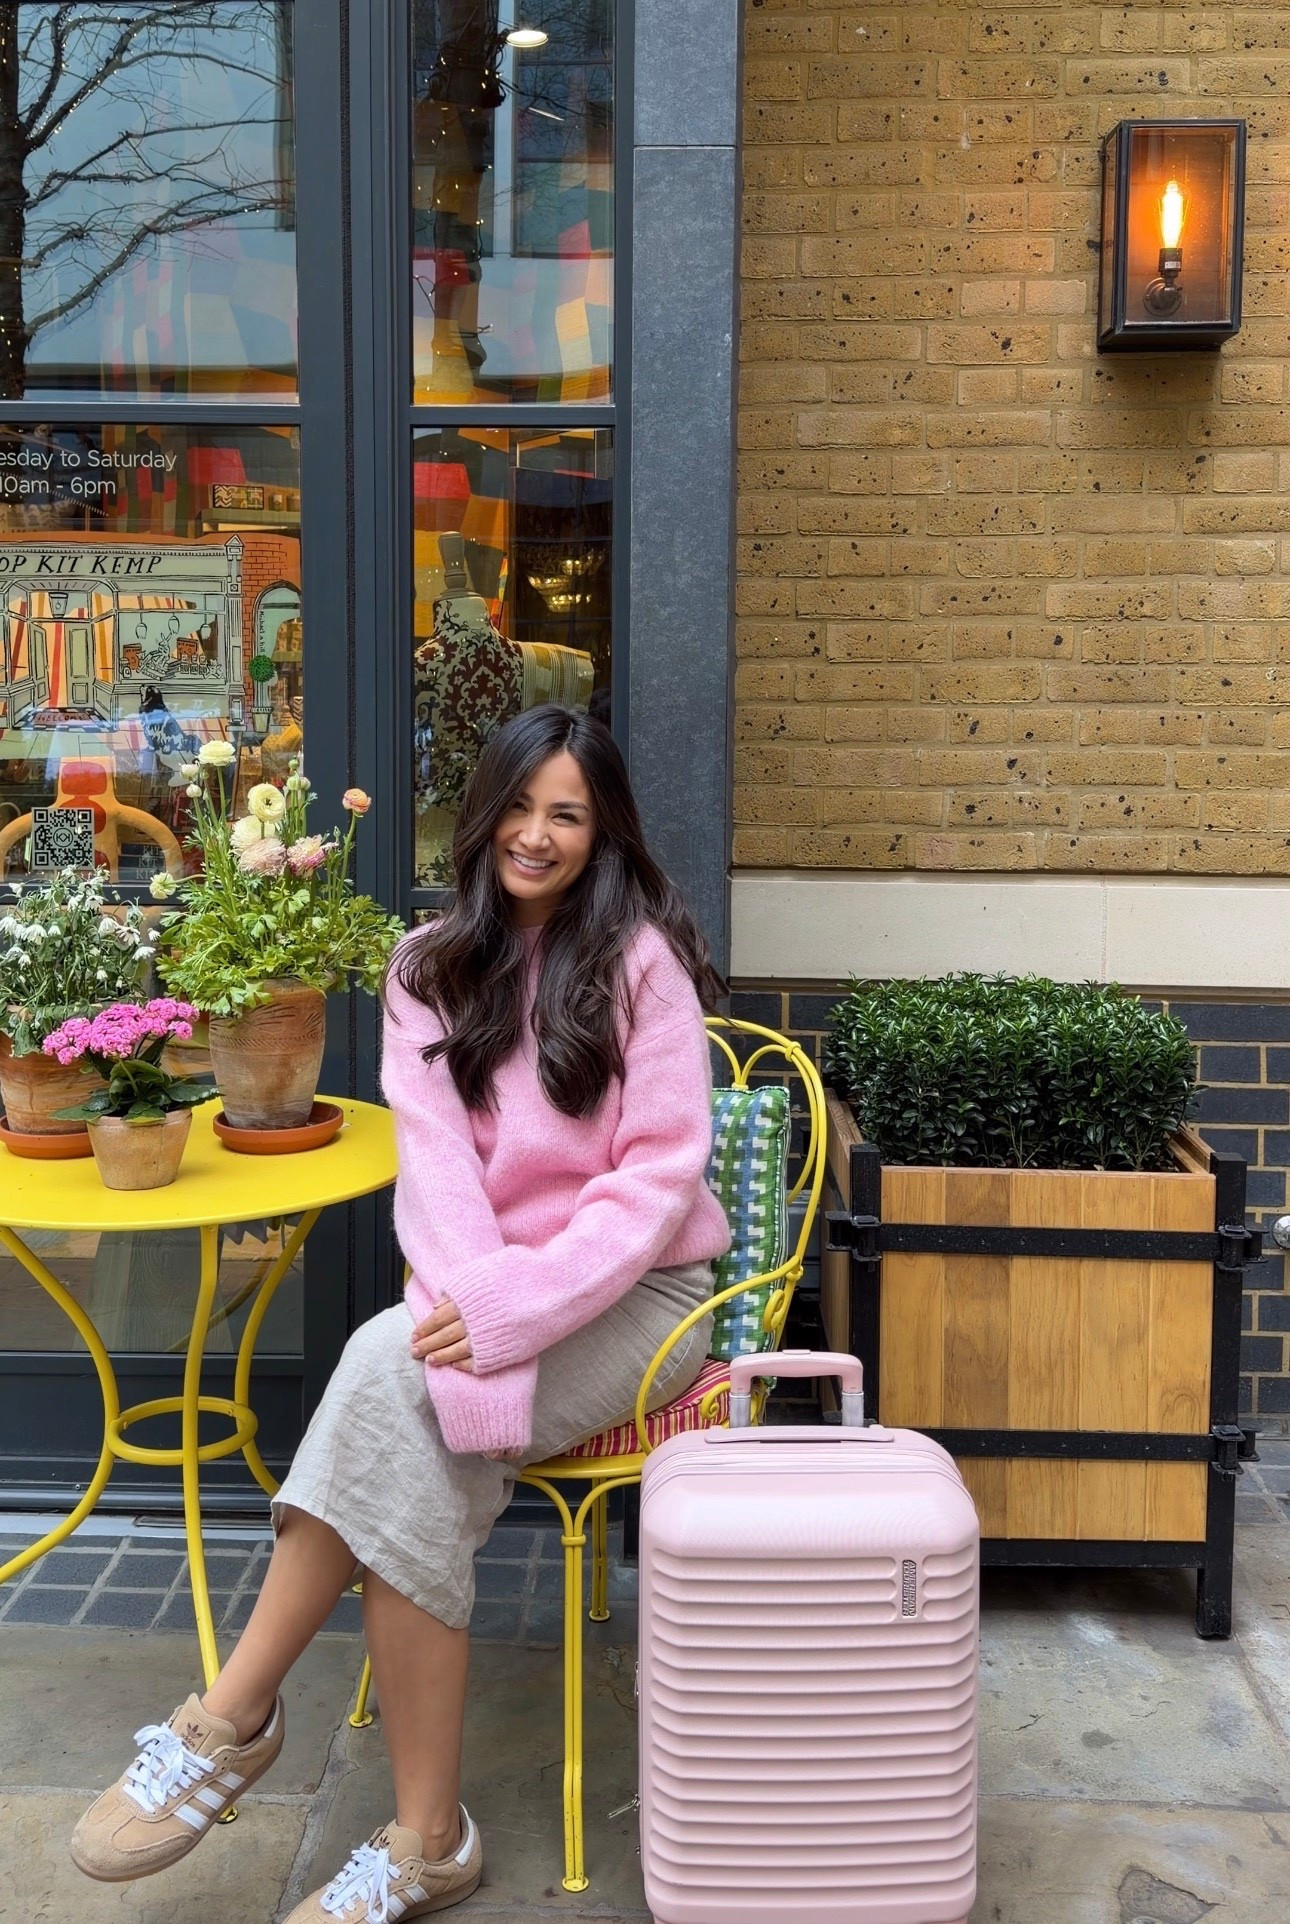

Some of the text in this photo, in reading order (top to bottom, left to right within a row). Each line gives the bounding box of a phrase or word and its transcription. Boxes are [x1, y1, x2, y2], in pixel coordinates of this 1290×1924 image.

[61, 450, 81, 467] to
[87, 450, 177, 471] Saturday
[70, 477, 116, 497] 6pm
[35, 555, 83, 574] KIT
[90, 555, 162, 575] KEMP
[143, 845, 160, 856] KIT
[138, 857, 158, 868] KIT
[908, 1560, 916, 1617] AMERICAN
